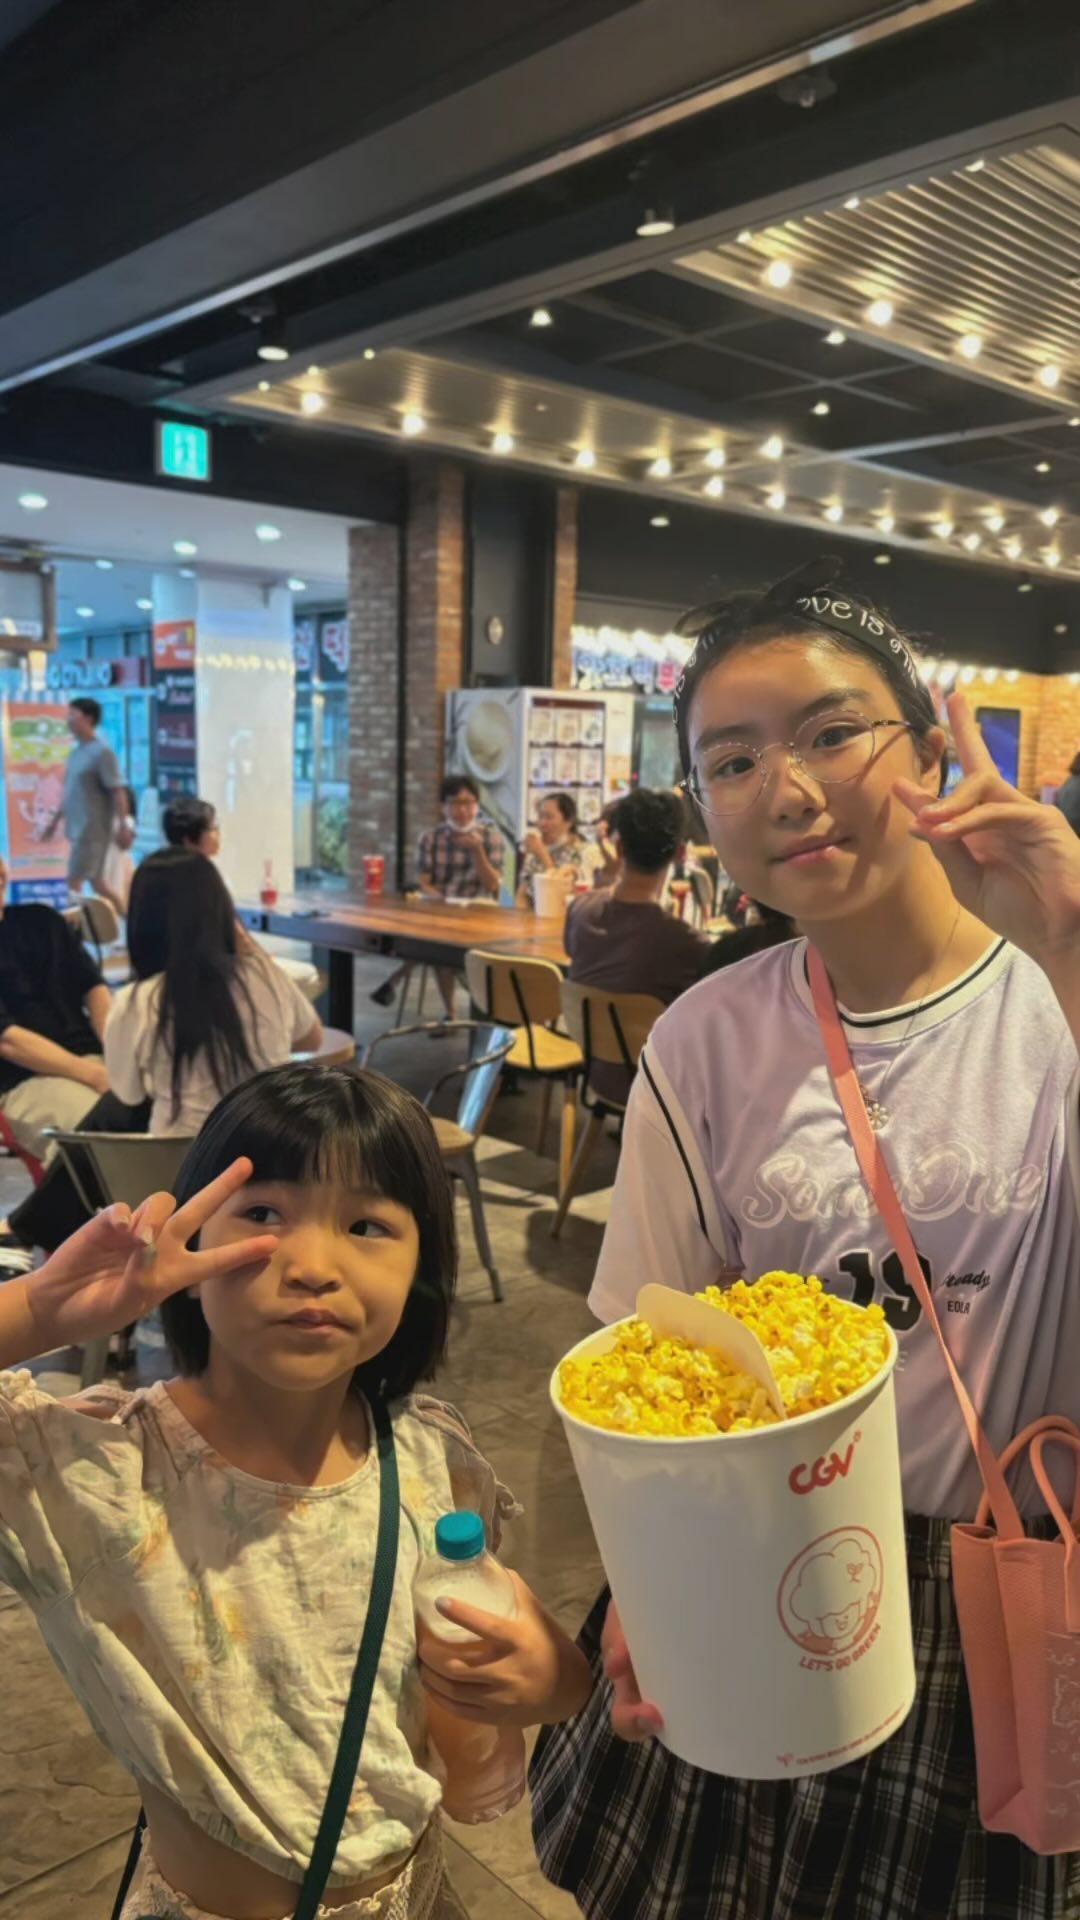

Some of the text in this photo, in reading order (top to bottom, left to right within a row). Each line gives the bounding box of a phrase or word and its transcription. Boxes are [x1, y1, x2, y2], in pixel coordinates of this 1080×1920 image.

[837, 1248, 932, 1331] 19
[788, 1442, 854, 1495] CGV
[835, 1655, 851, 1671] GO
